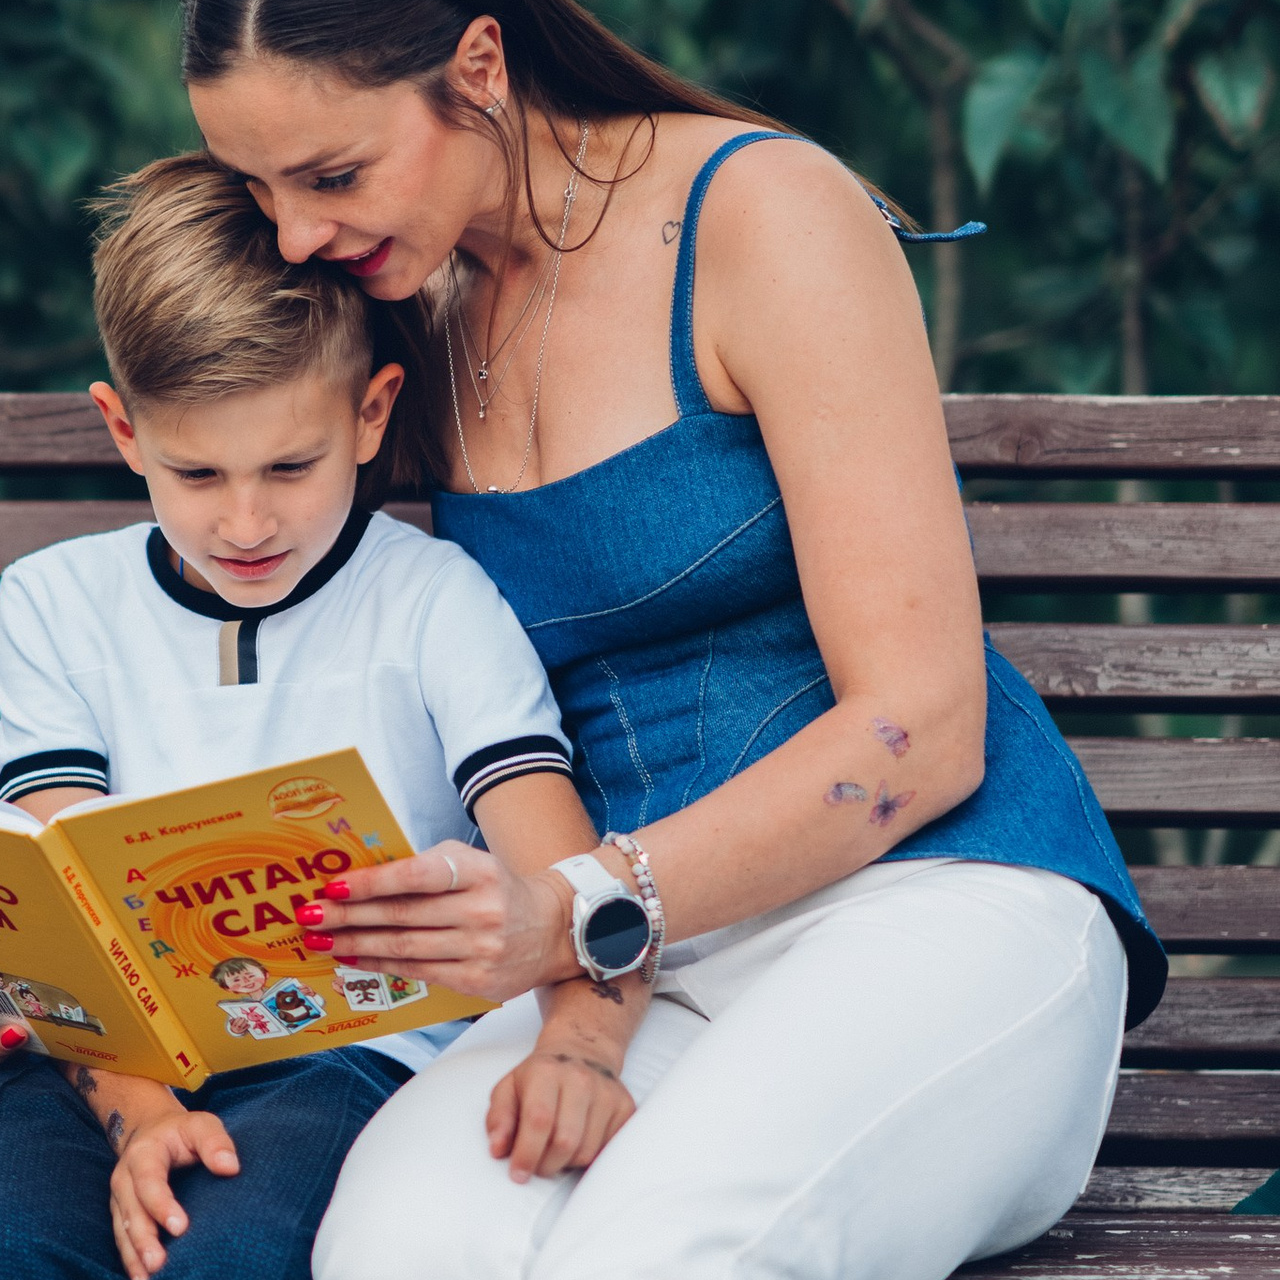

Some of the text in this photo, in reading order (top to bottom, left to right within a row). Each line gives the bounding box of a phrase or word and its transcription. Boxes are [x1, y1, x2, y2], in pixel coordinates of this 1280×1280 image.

[157, 810, 244, 836] Корсунская
[125, 868, 147, 883] А
[154, 848, 352, 909] ЧИТАЮ
[122, 894, 145, 910] Б
[137, 918, 153, 932] Е
[149, 939, 176, 959] Д
[265, 934, 305, 950] КНИ
[290, 946, 307, 961] 1
[108, 938, 159, 1018] ЧИТАЮ САМ
[171, 962, 200, 979] Ж
[327, 1014, 379, 1034] ВЛАДОС
[175, 1050, 191, 1068] 1
